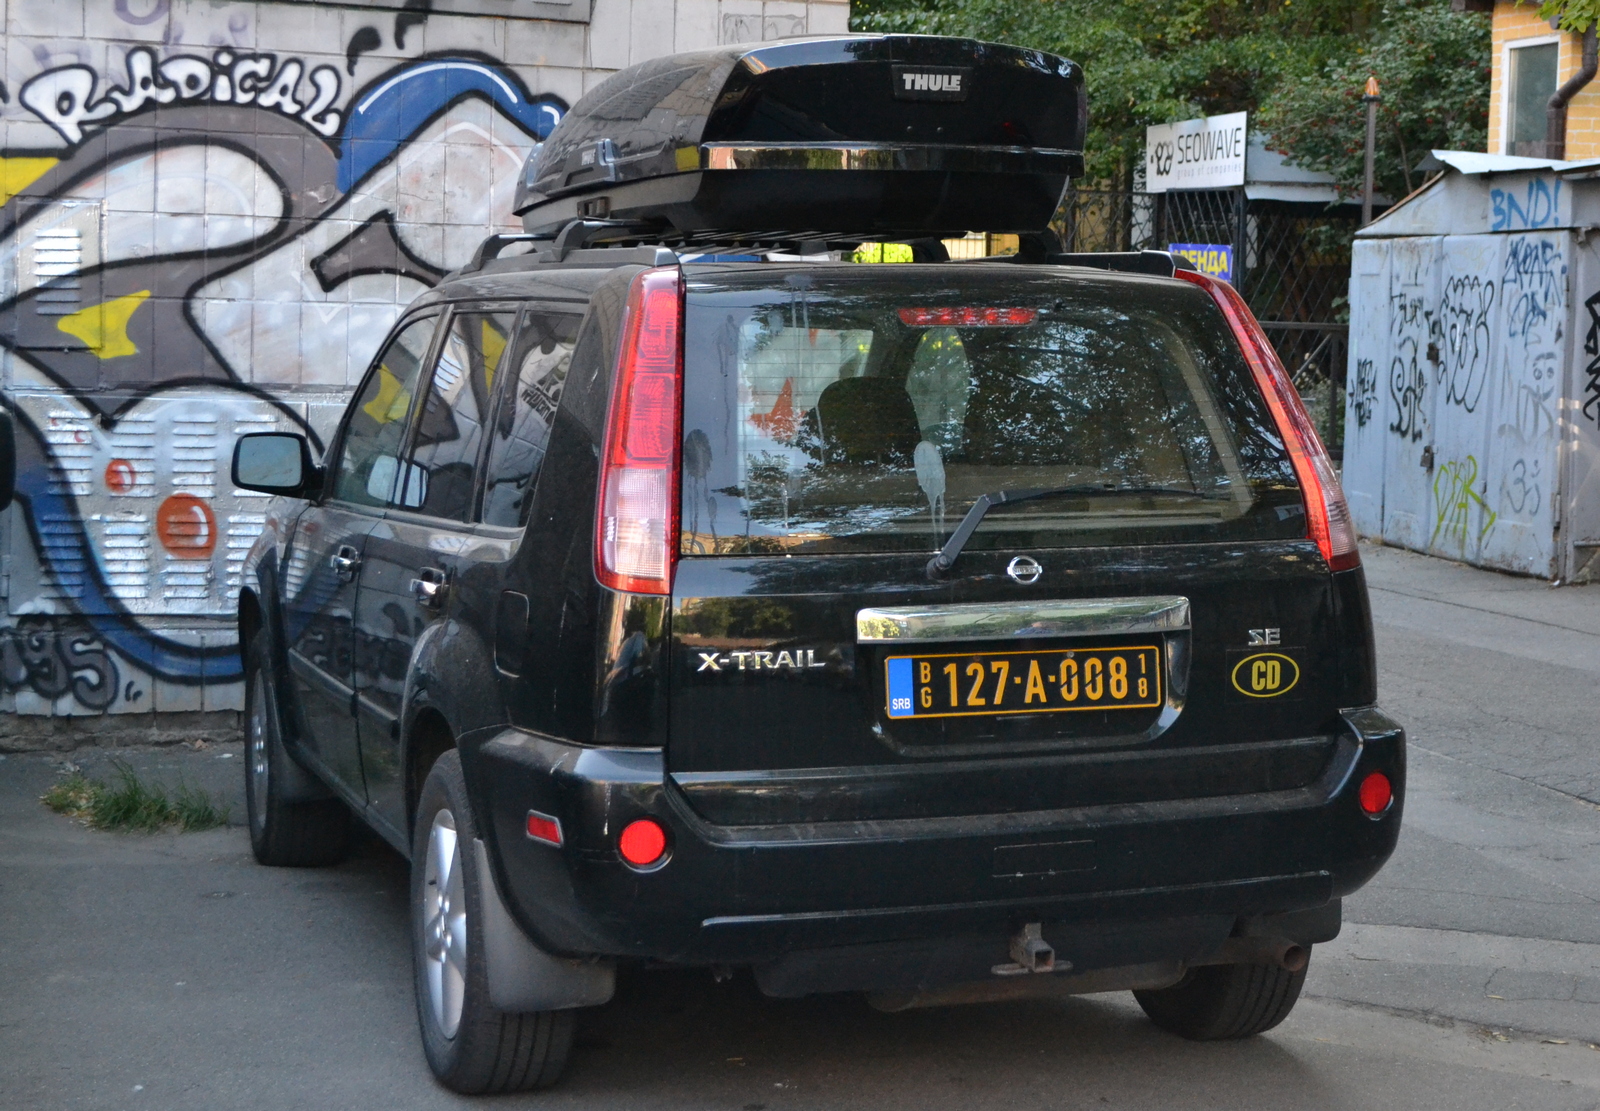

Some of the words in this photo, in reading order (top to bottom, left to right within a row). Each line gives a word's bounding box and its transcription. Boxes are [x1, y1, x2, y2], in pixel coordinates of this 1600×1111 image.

[903, 73, 962, 91] THULE
[1177, 127, 1242, 164] SEOWAVE
[1206, 162, 1242, 175] companies
[1248, 628, 1281, 646] SE
[697, 650, 827, 672] X-TRAIL
[1251, 660, 1281, 691] CD
[892, 698, 911, 710] SRB
